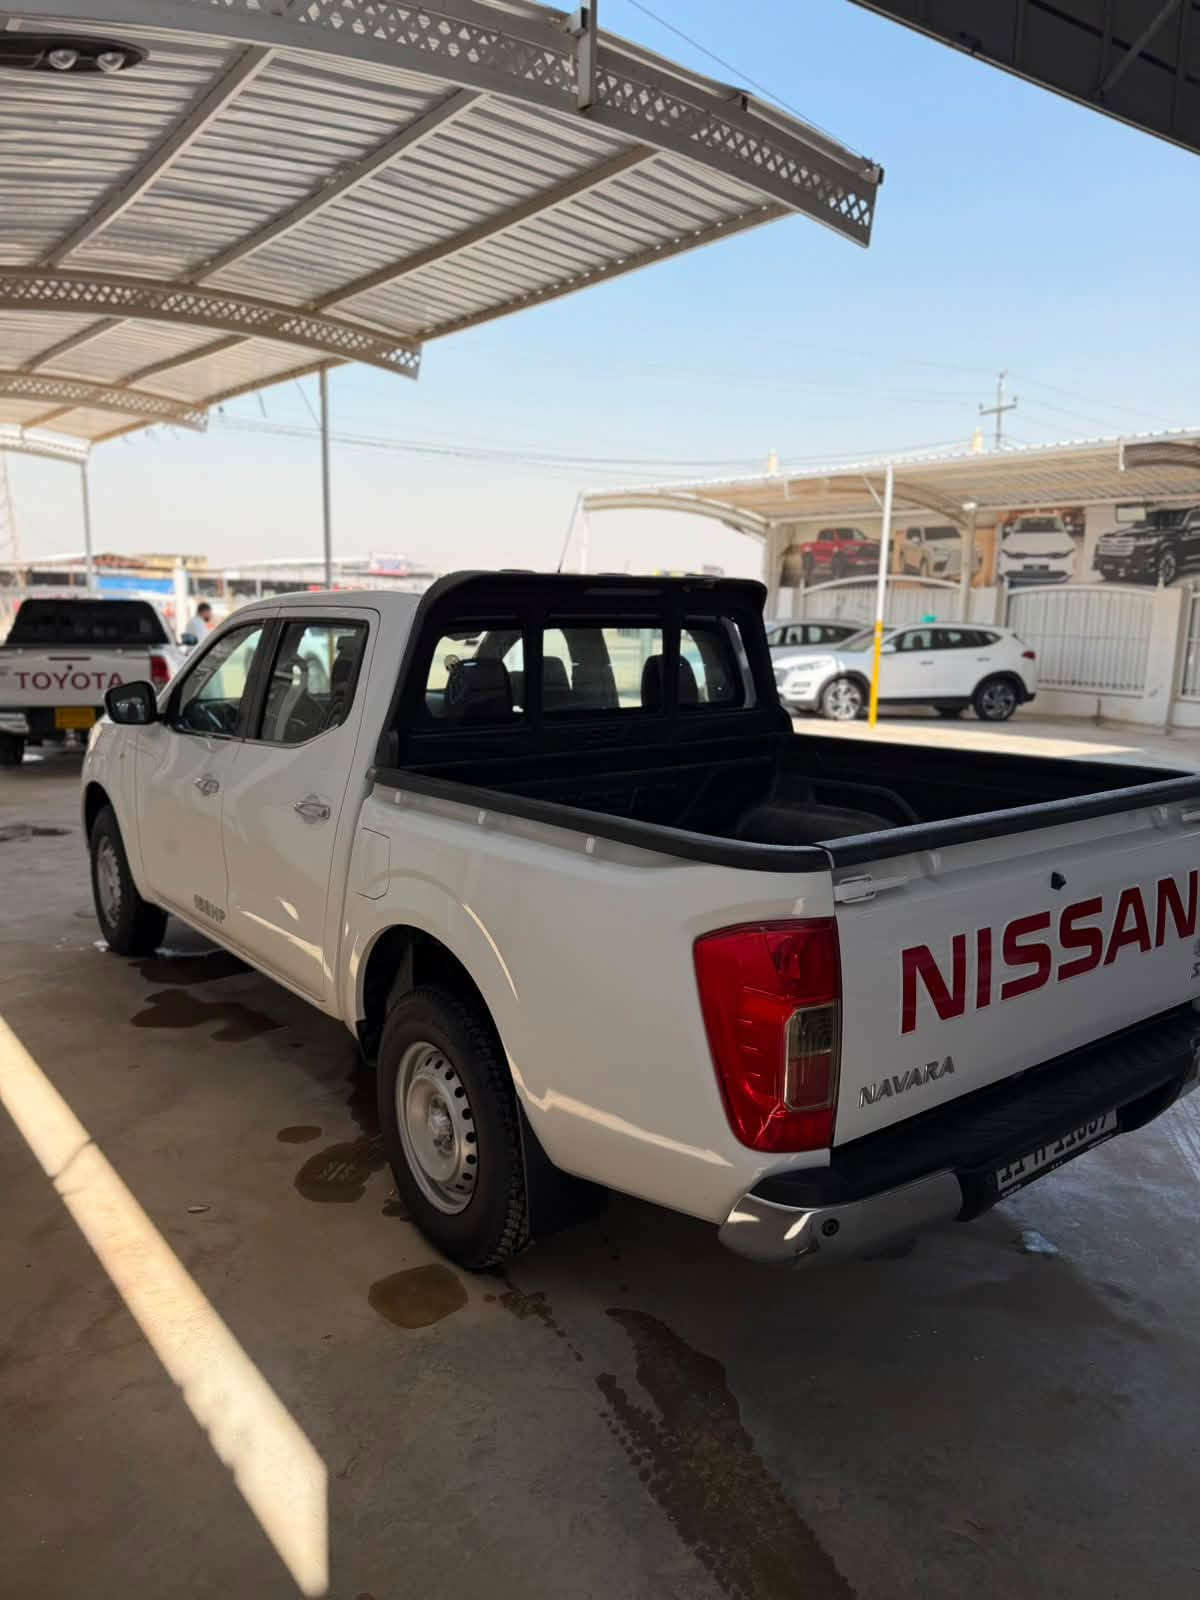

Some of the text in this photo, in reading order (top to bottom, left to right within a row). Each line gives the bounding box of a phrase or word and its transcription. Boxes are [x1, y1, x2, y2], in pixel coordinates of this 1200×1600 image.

[14, 671, 124, 690] TOYOTA
[901, 870, 1198, 1034] NISSAN
[858, 1056, 955, 1108] NAVARA
